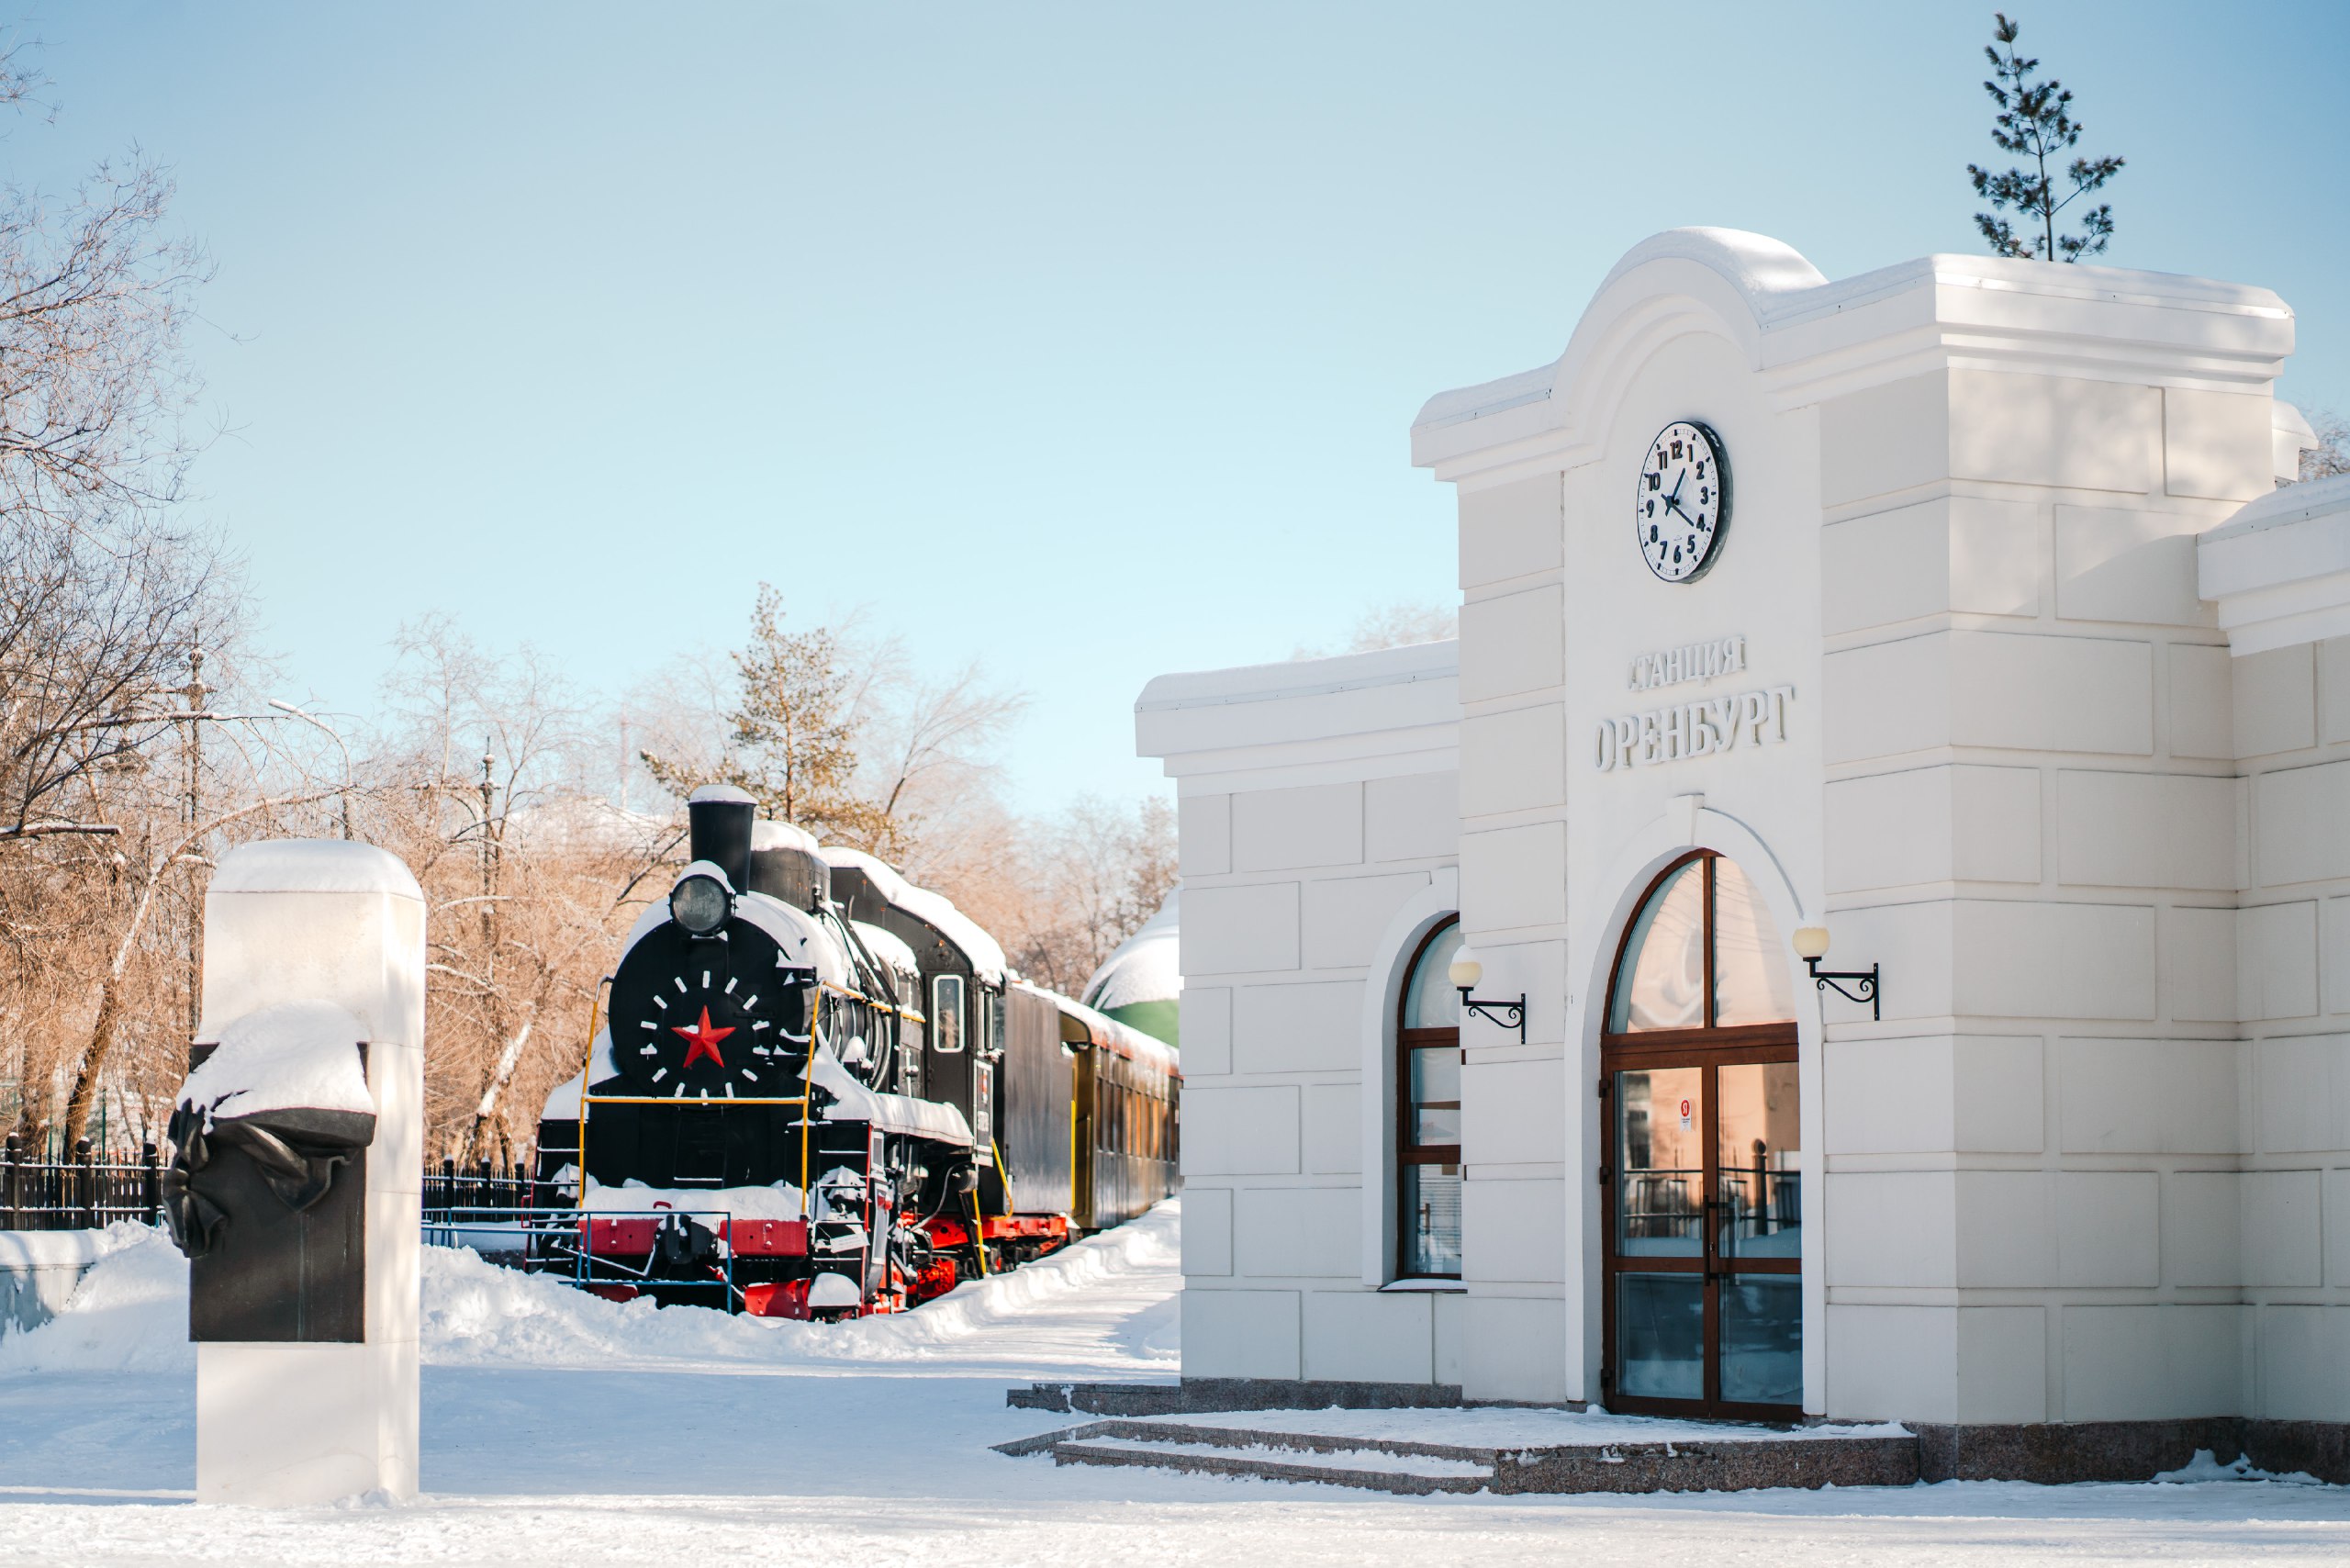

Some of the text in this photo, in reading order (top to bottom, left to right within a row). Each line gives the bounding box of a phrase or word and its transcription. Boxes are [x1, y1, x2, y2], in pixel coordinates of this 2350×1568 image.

[1670, 440, 1683, 460] 12
[1687, 444, 1694, 462] 1
[1657, 451, 1668, 470] 11
[1696, 461, 1705, 480] 2
[1647, 472, 1661, 491] 10
[1700, 487, 1708, 505] 3
[1646, 499, 1654, 518] 9
[1696, 513, 1706, 532] 4
[1650, 525, 1658, 543] 8
[1660, 541, 1667, 560] 7
[1686, 534, 1695, 554] 5
[1673, 545, 1681, 564] 6
[1626, 635, 1746, 692] СТАНЦИЯ
[1594, 685, 1795, 773] ОРЕНБУРГ
